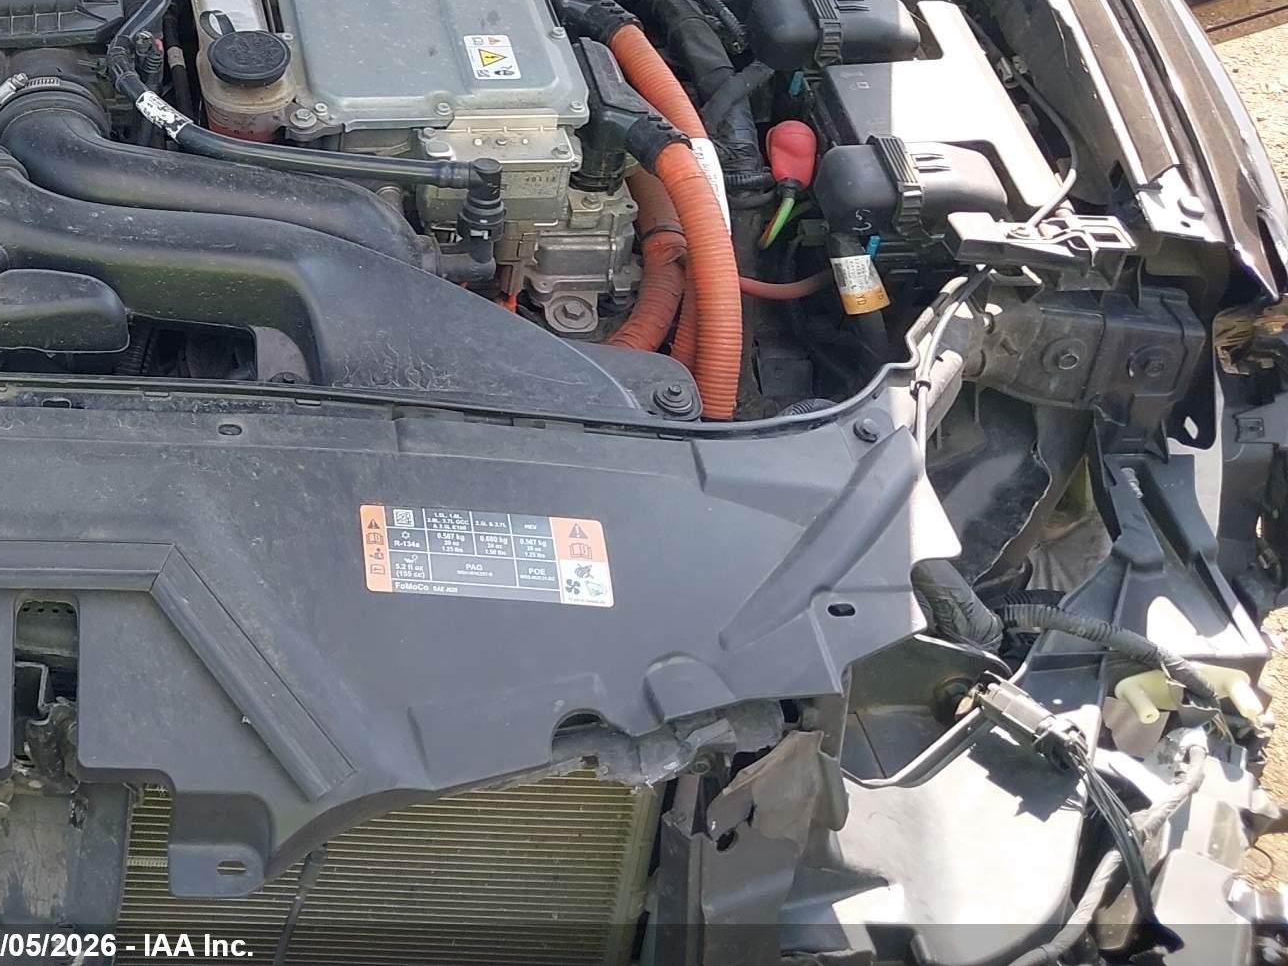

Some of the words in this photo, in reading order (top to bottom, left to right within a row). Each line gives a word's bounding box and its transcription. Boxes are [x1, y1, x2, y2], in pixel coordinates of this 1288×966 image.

[456, 533, 465, 541] kg
[499, 537, 508, 545] kg
[393, 539, 421, 548] R-134a
[465, 563, 483, 571] PAG
[528, 567, 546, 576] POE
[395, 582, 429, 591] FoMoCo
